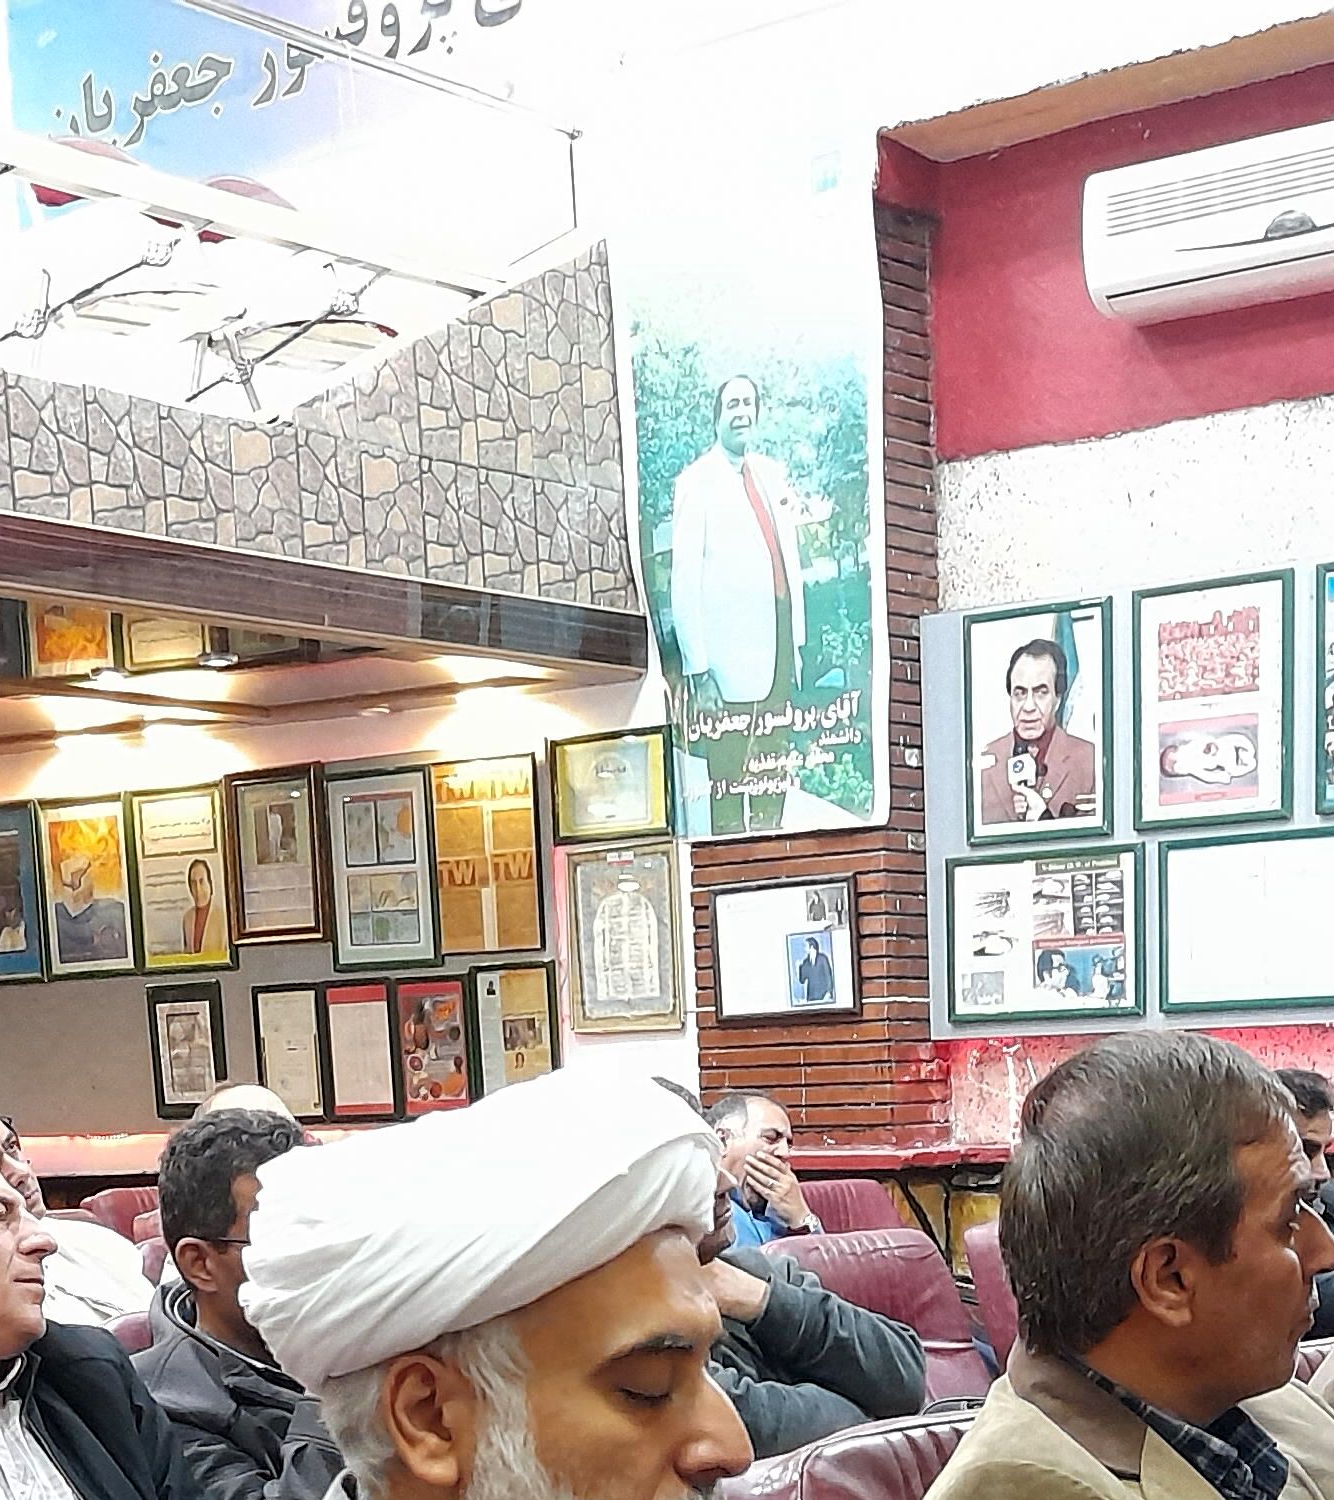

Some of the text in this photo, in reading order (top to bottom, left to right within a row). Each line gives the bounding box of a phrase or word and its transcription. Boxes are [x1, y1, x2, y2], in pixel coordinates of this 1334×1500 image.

[688, 689, 862, 742] آقای پروفسور جعفریان
[818, 727, 862, 746] دانشمند
